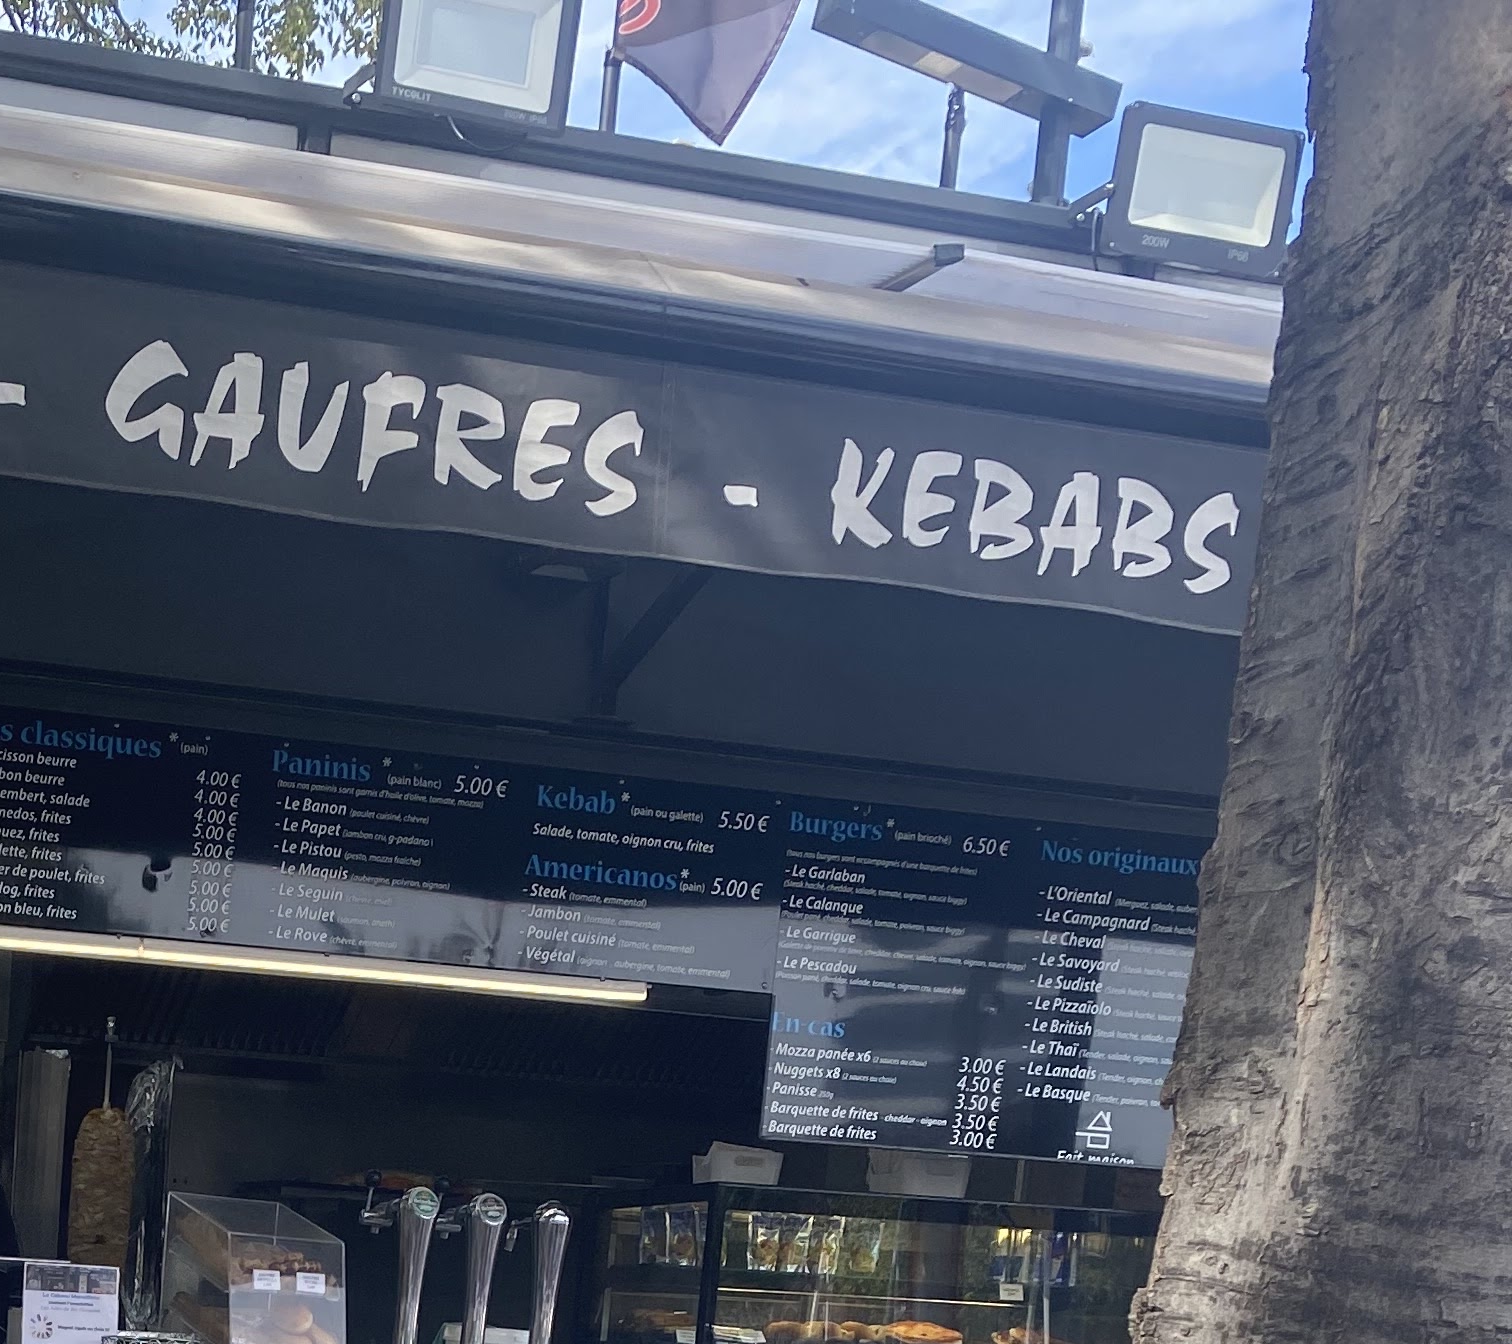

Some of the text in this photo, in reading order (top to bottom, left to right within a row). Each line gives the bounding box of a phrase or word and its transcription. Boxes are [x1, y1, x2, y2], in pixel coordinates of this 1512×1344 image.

[1142, 234, 1170, 249] 200W
[104, 338, 645, 517] GAUFRES
[830, 438, 1241, 595] KEBABS
[21, 721, 162, 760] classiques
[37, 755, 77, 768] beurre
[272, 750, 371, 781] Paninis
[454, 775, 493, 795] 5.00
[284, 796, 347, 816] Le Banon
[538, 785, 616, 814] Kebab
[718, 811, 755, 831] 5.50
[789, 811, 883, 842] Burgers
[533, 823, 714, 854] Salade, tomate, oignon cru, frites
[1041, 840, 1199, 875] Nos originaux
[524, 854, 678, 889] Americanos
[711, 878, 749, 898] 5.00
[1044, 909, 1151, 931] Le Campagnard
[768, 1121, 877, 1140] Barquette de frites
[951, 1132, 984, 1147] 3.00
